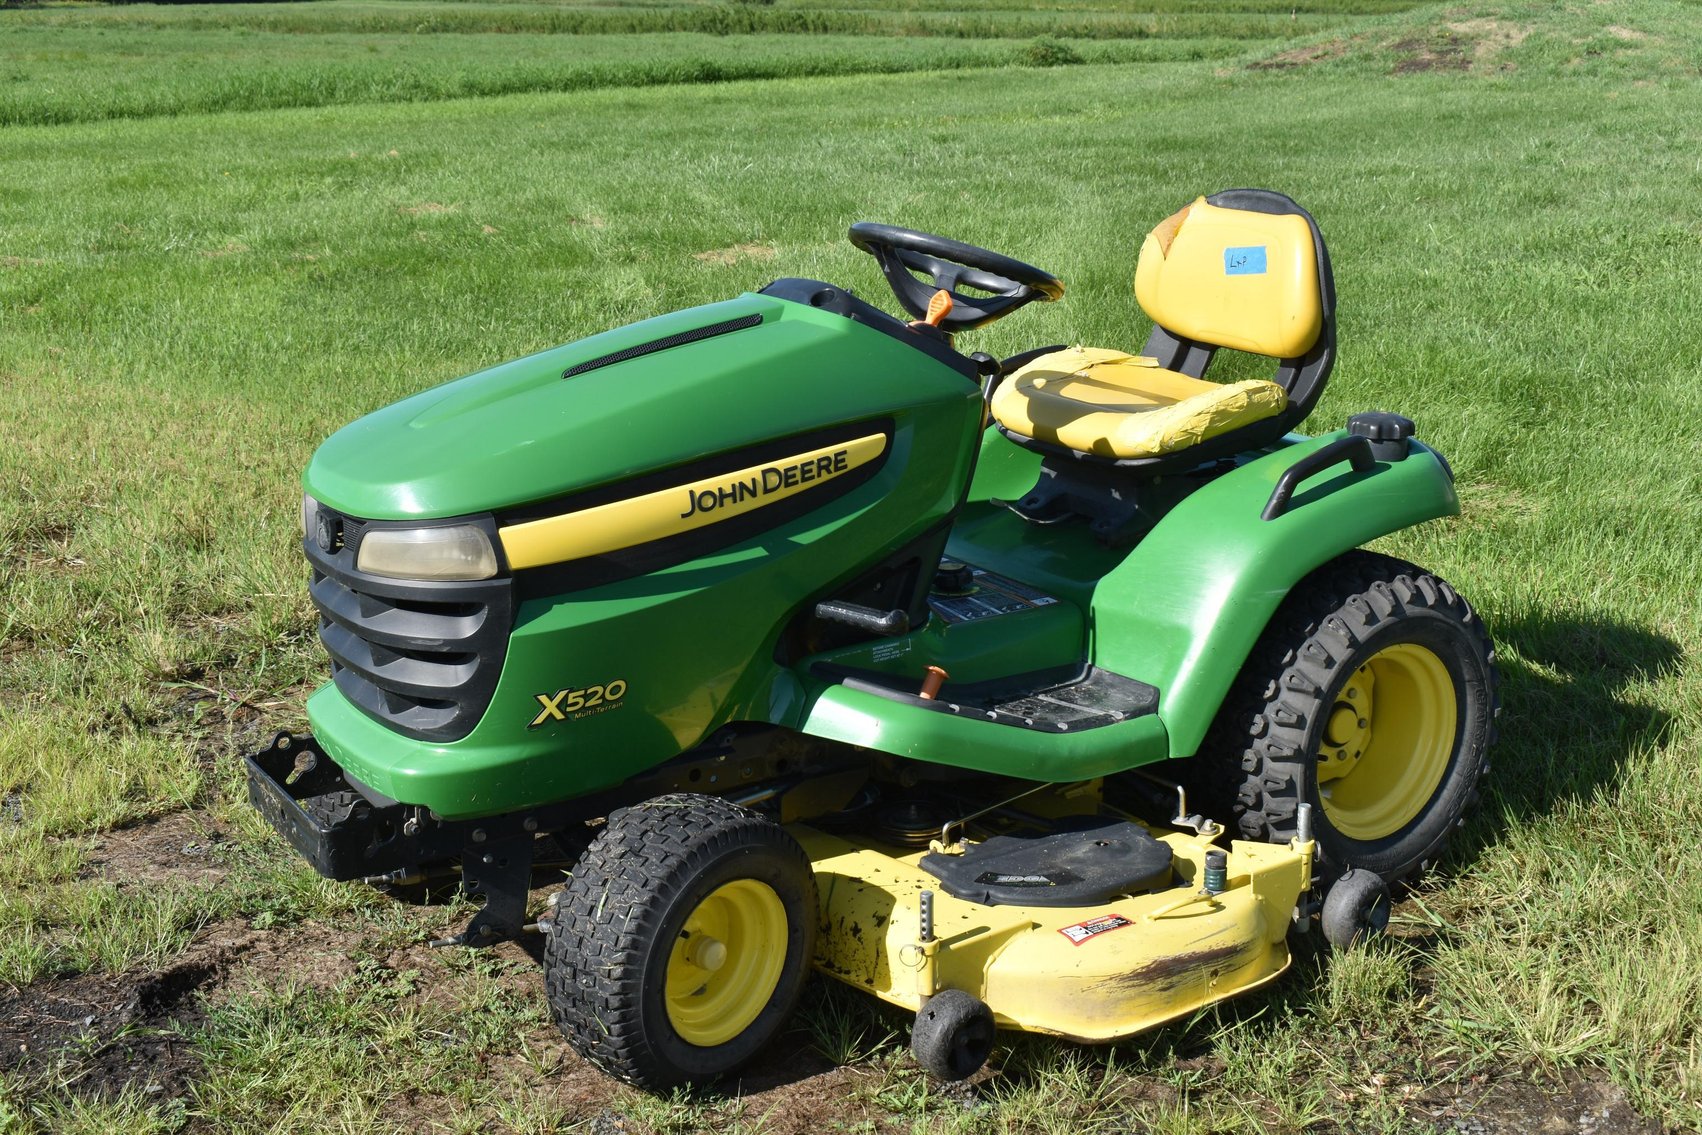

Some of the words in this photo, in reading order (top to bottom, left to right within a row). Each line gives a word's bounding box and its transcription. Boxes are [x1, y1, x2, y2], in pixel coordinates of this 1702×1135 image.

[681, 477, 757, 519] JOHN
[760, 450, 848, 495] DEERE
[529, 679, 627, 727] X520
